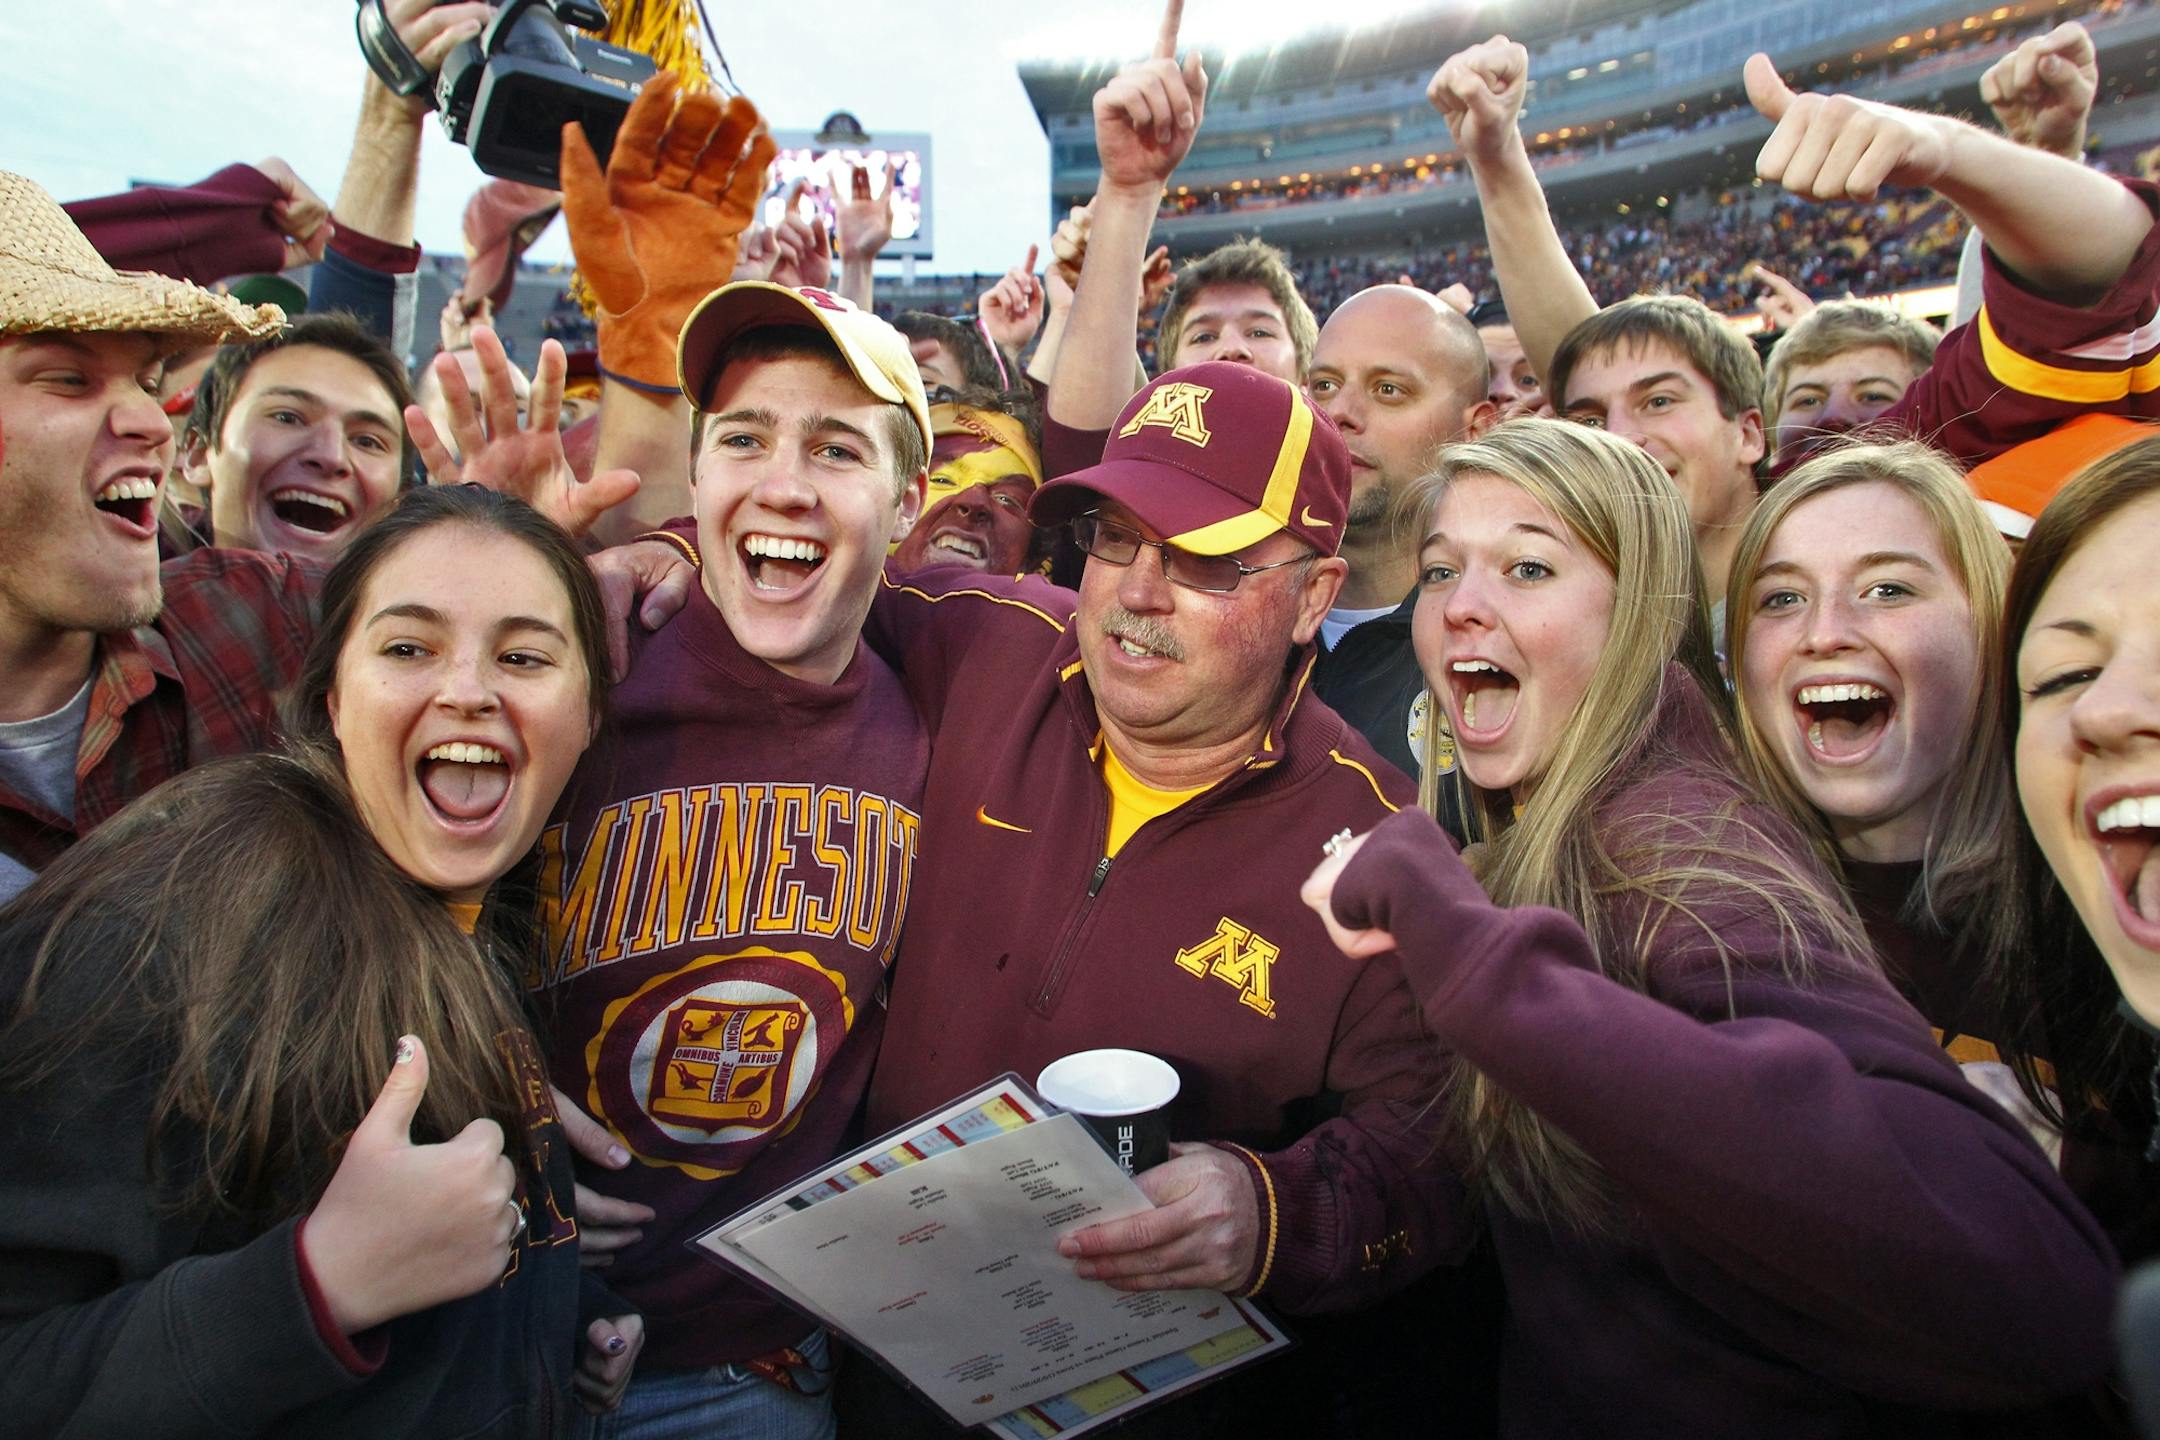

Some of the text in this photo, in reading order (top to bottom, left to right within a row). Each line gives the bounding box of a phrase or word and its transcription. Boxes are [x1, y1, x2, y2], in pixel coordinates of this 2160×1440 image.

[1117, 381, 1214, 449] M
[527, 782, 921, 990] MINNESOT
[1174, 916, 1281, 1016] M
[675, 1048, 778, 1064] OMNIBUS ARTIBUS
